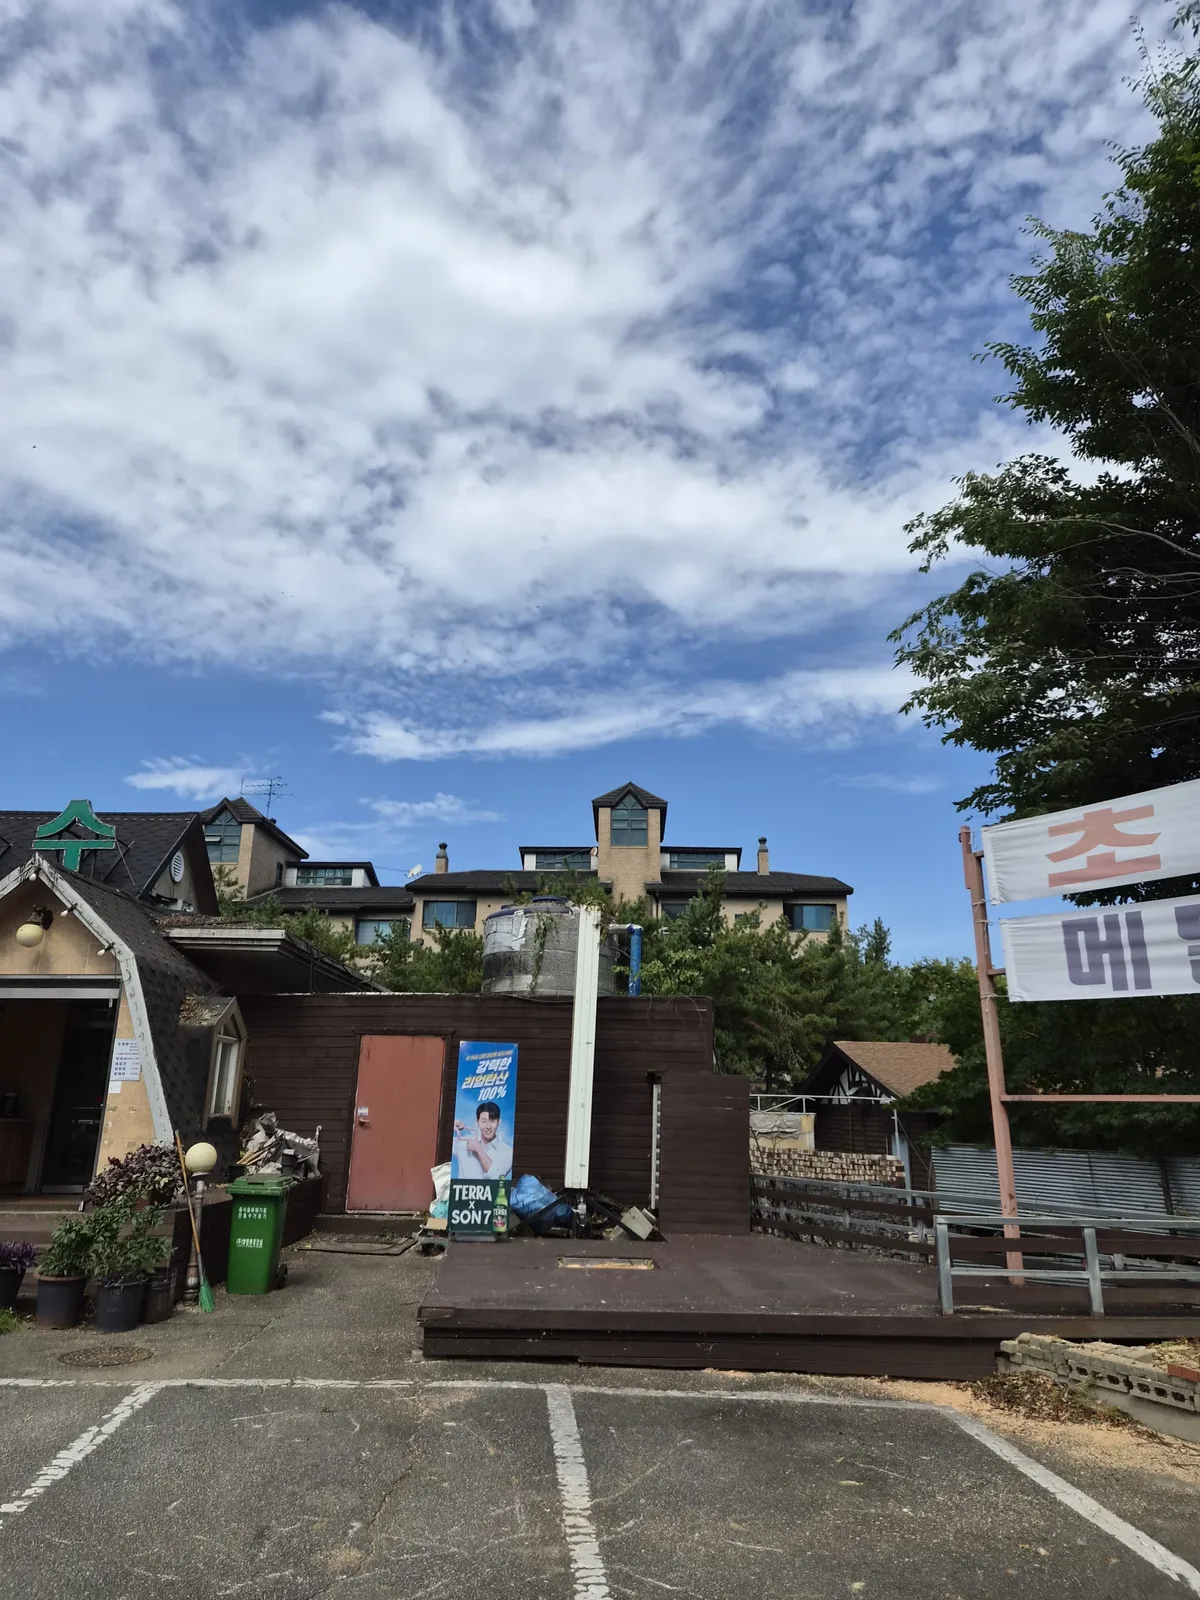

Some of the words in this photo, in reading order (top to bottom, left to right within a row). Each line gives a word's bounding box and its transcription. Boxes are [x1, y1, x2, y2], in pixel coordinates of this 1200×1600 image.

[32, 799, 116, 872] 수
[1045, 804, 1162, 888] 초
[475, 1056, 512, 1074] 강력한
[461, 1071, 509, 1090] 리얼탄산
[477, 1084, 508, 1102] 100%
[452, 1184, 493, 1202] TERRA
